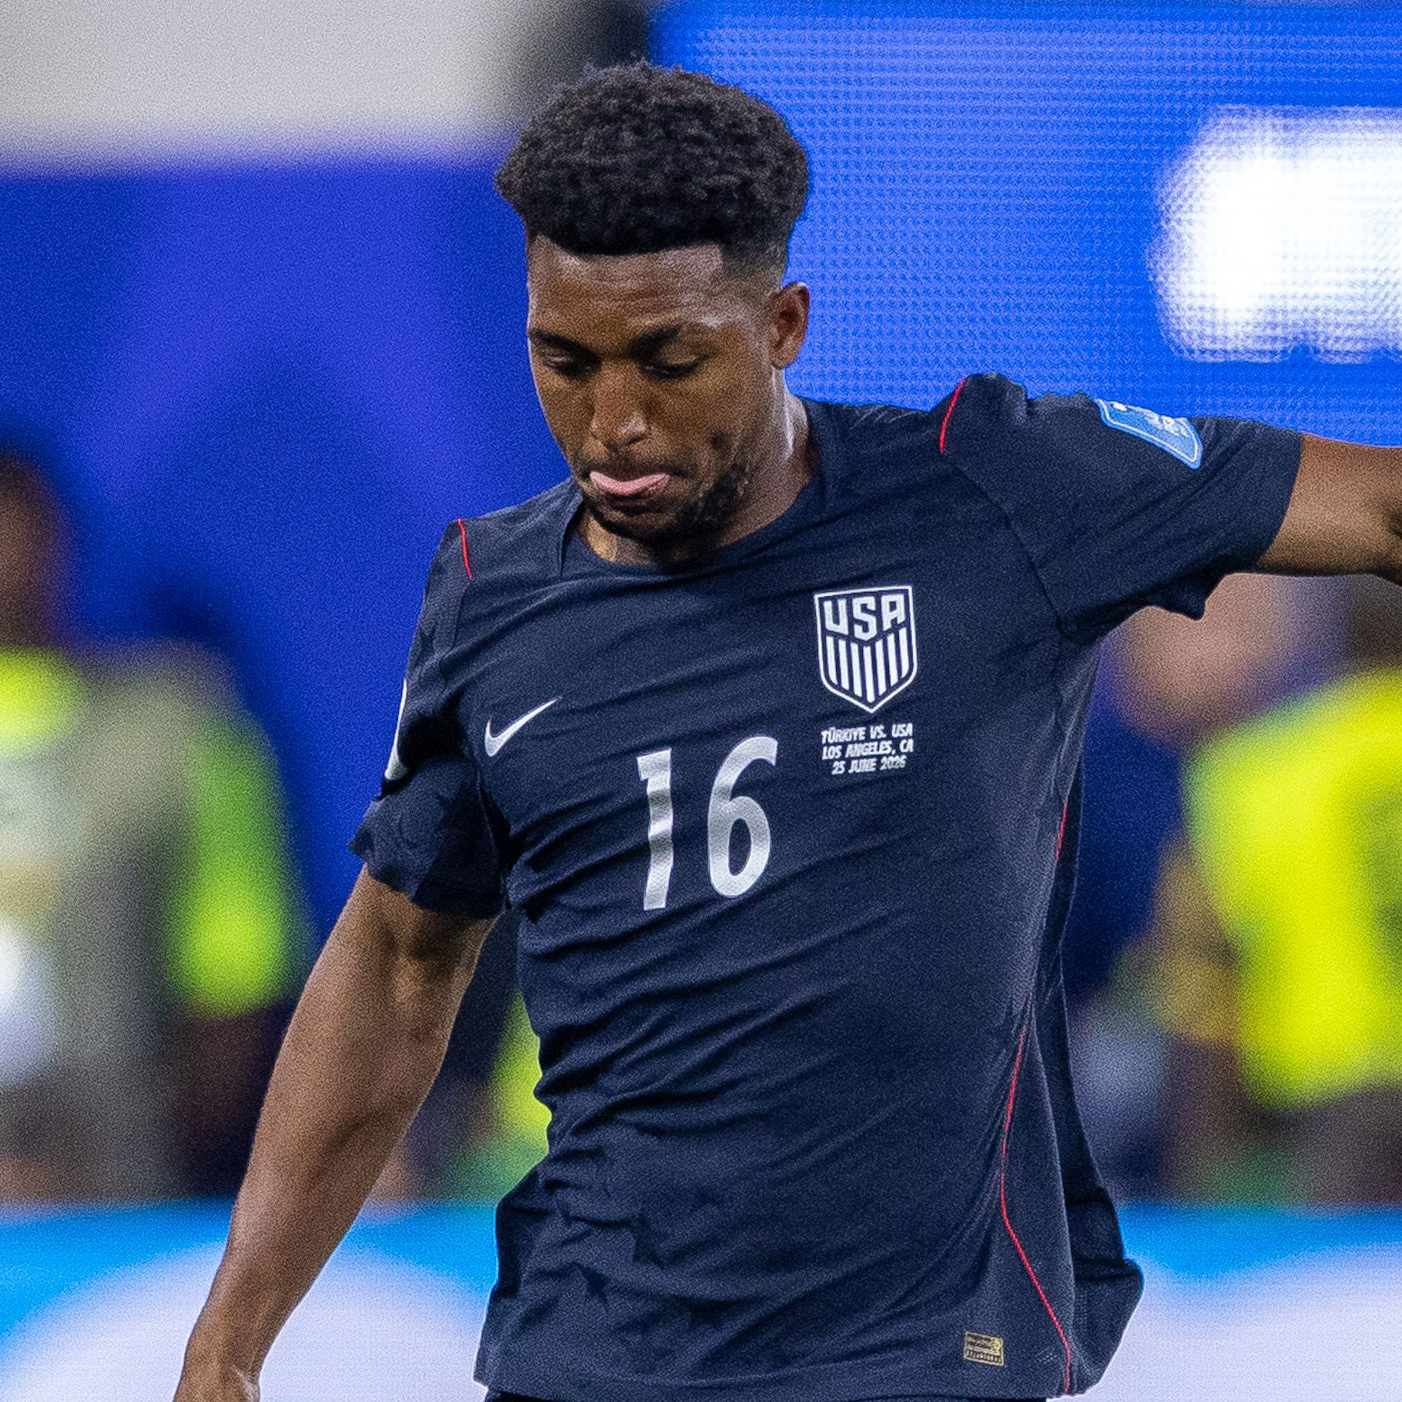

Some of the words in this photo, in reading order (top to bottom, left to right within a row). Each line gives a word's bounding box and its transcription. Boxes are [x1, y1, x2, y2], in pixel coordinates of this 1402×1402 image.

[823, 594, 906, 641] USA
[891, 723, 913, 738] USA
[822, 745, 842, 760] LOS
[845, 740, 896, 758] ANGELES,
[900, 738, 914, 752] CA
[831, 760, 846, 775] 25
[848, 758, 877, 773] JUNE
[880, 755, 907, 770] 2026
[637, 737, 778, 910] 16
